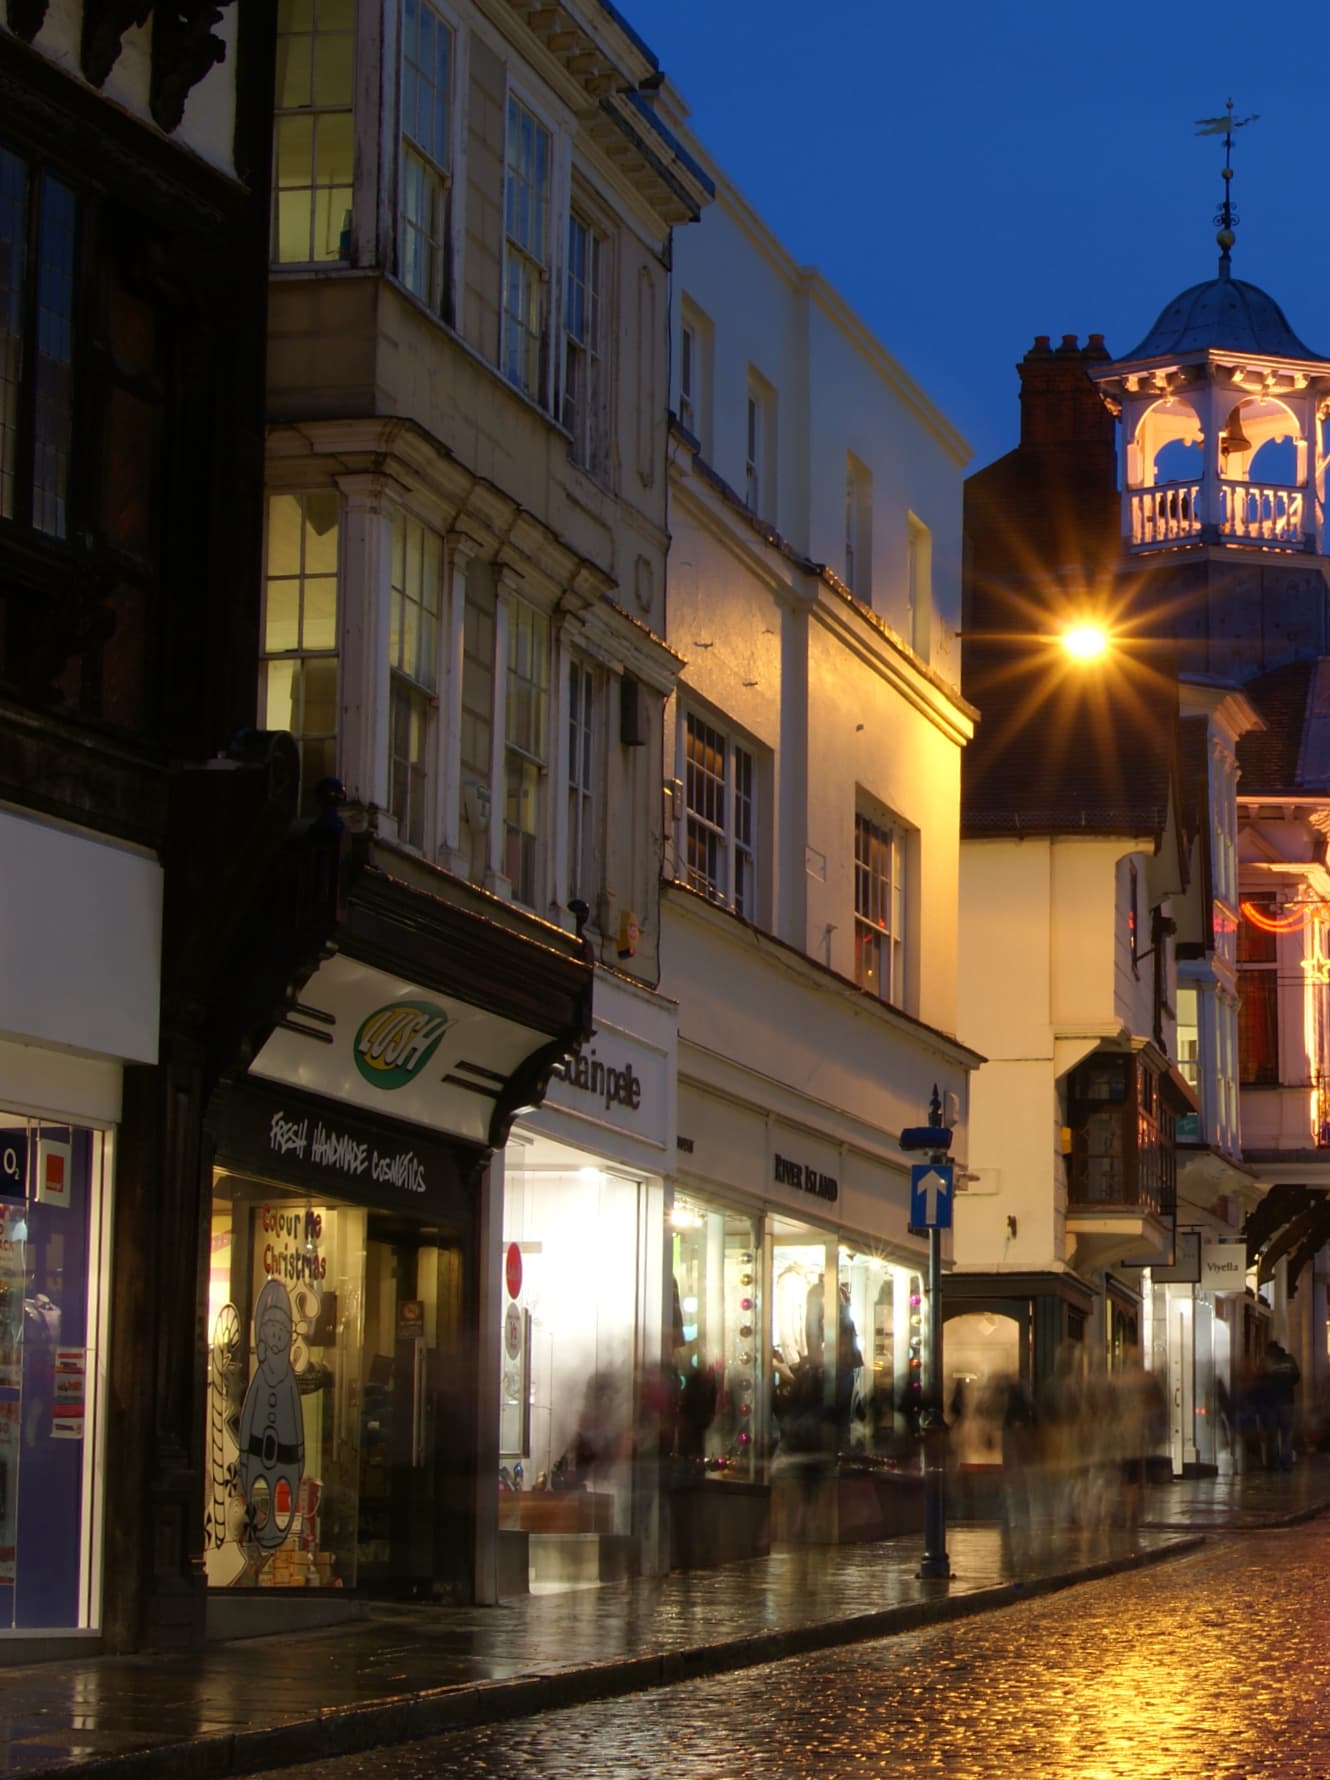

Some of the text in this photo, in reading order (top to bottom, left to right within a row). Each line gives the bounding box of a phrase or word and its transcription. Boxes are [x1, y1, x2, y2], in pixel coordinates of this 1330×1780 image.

[357, 1009, 457, 1072] LUSH
[269, 1110, 427, 1193] FRESH HANDMADE COSMETICS
[774, 1153, 838, 1203] RIVER ISLAND
[263, 1243, 327, 1281] Christmas
[1207, 1262, 1239, 1274] Viyella
